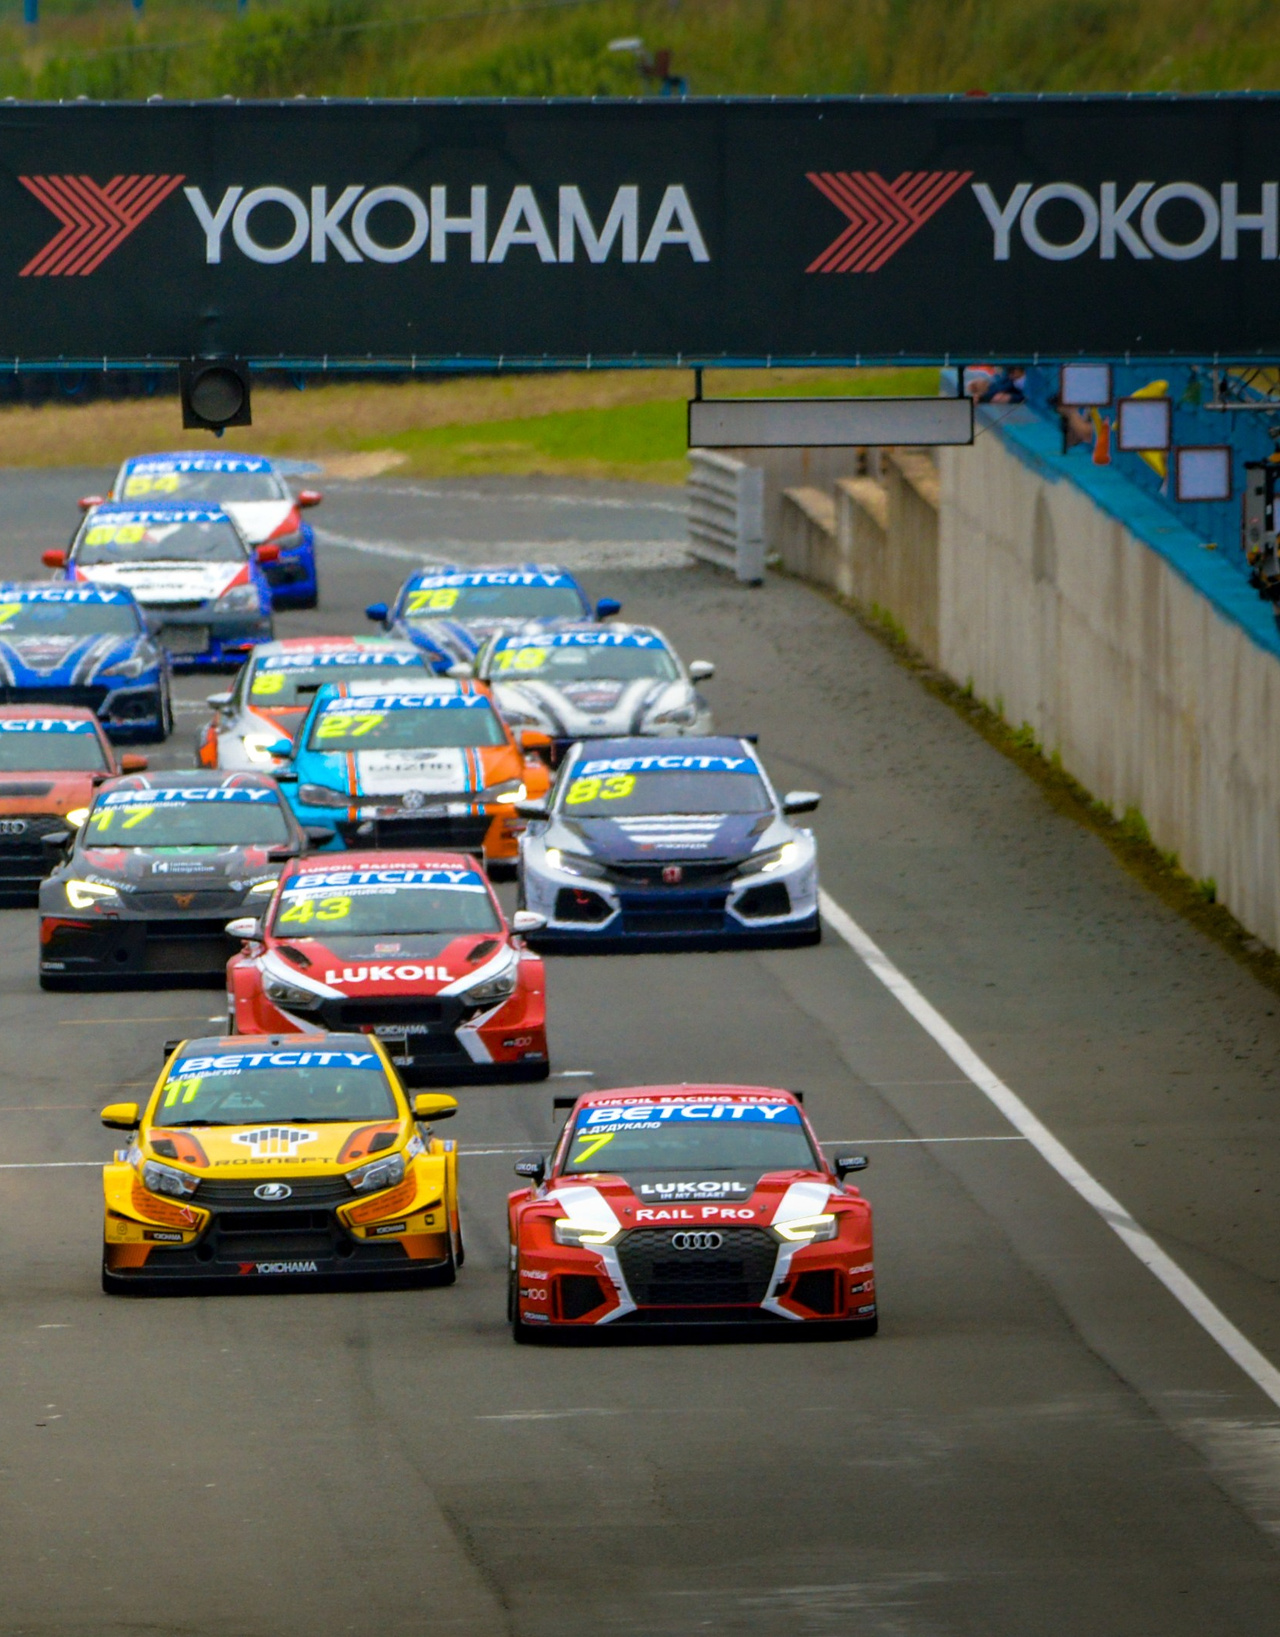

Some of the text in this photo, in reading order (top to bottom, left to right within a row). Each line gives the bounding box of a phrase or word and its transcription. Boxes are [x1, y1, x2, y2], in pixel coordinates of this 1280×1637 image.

[183, 184, 710, 264] YOKOHAMA
[971, 180, 1279, 261] YOKOH
[420, 574, 562, 588] BETCITY
[506, 633, 653, 648] BETCITY
[264, 653, 417, 668] BETCITY
[252, 673, 285, 694] 8
[326, 695, 482, 711] BETCITY
[316, 714, 384, 738] 27
[581, 755, 745, 774] BETCITY
[104, 788, 271, 805] BETCITY
[565, 775, 636, 805] 83
[90, 807, 155, 831] 17
[300, 865, 353, 874] LUKOIL
[295, 870, 470, 888] BETCITY
[280, 896, 352, 923] 43
[325, 965, 456, 984] LUKOIL
[180, 1052, 374, 1073] BETCITY
[163, 1078, 202, 1108] 11
[588, 1096, 787, 1107] LUKOIL RACING TEAM
[587, 1104, 788, 1124] BETCITY
[573, 1132, 615, 1163] 7
[215, 1157, 333, 1167] ROSNEFT
[641, 1181, 747, 1195] LUKOIL
[661, 1190, 726, 1199] IN MY HEART
[636, 1208, 694, 1221] RAIL
[256, 1261, 317, 1274] YOKOHAMA
